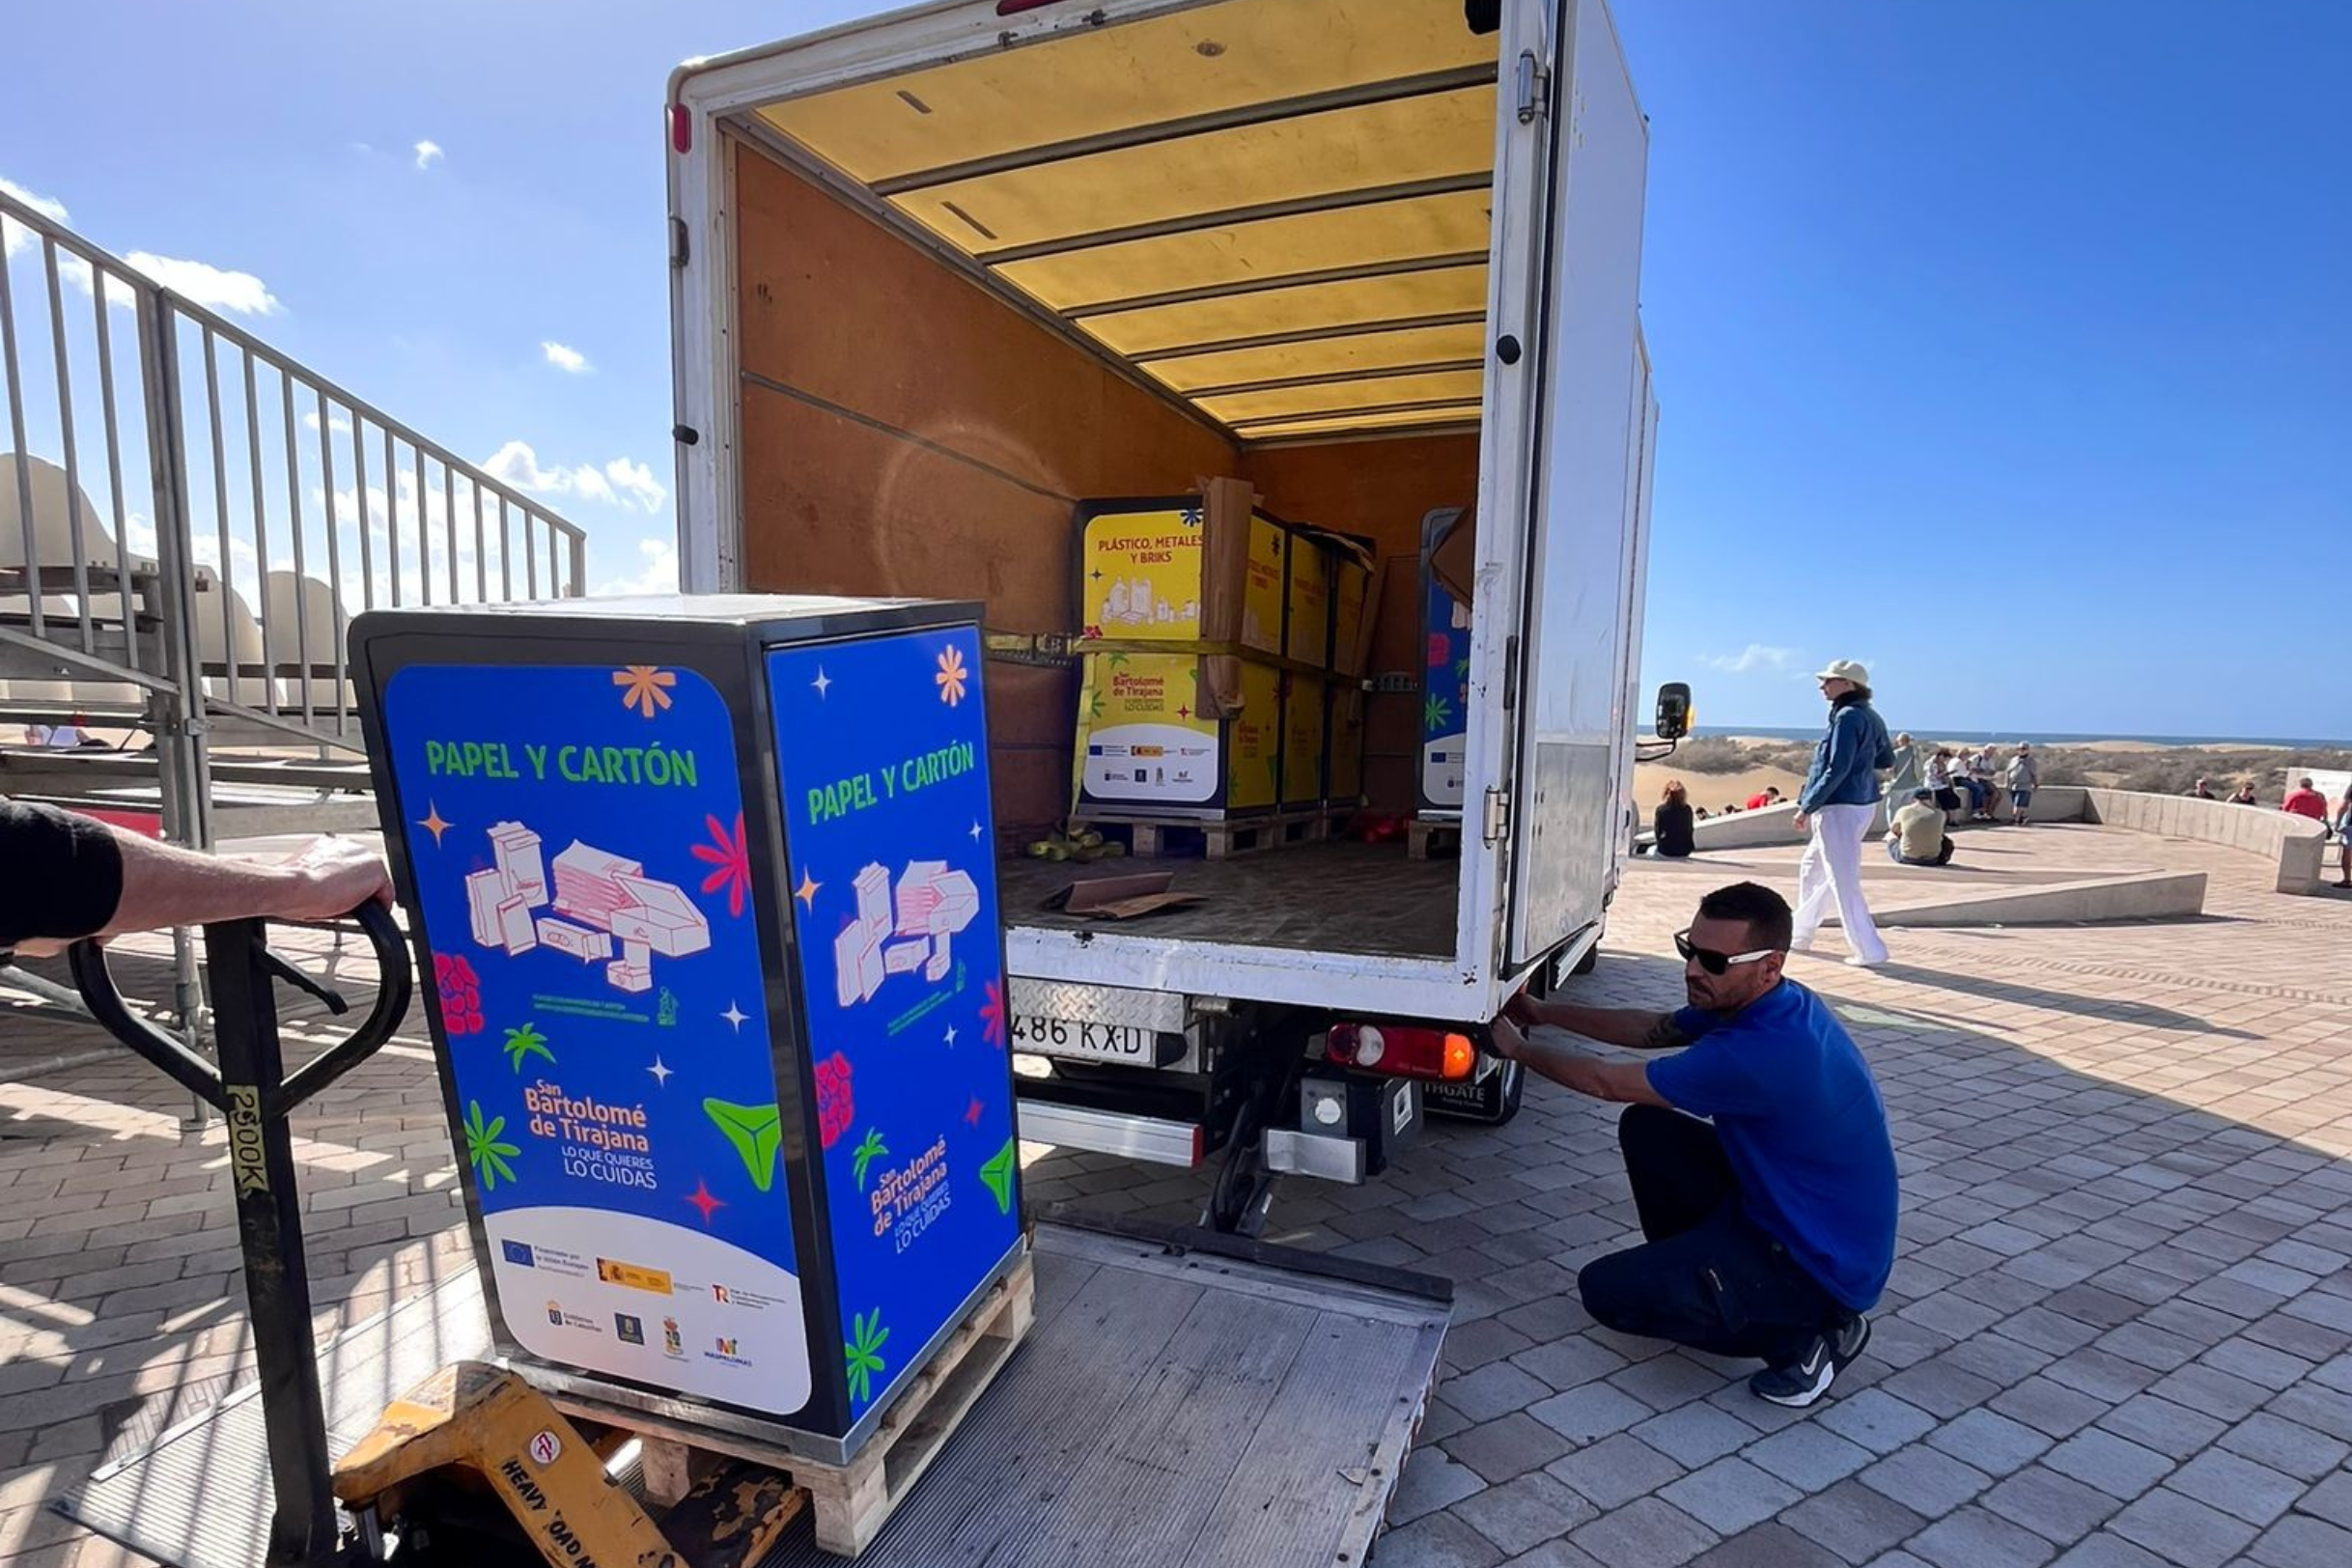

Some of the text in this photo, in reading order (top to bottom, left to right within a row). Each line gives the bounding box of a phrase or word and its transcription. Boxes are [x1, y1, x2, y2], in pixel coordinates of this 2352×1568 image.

[1098, 537, 1153, 551] PLÁSTICO,
[1131, 551, 1172, 564] Y BRIKS
[426, 741, 697, 787] PAPEL Y CARTÓN
[808, 740, 974, 825] PAPEL Y CARTÓN
[1081, 1022, 1140, 1054] KXD
[537, 1079, 561, 1096] San
[525, 1087, 646, 1128] Bartolomé
[530, 1114, 649, 1152] de Tirajana
[561, 1145, 654, 1169] LO QUE QUIERES
[565, 1158, 658, 1189] LO CUIDAS
[871, 1134, 946, 1215] Bartolomé
[875, 1212, 892, 1236] de
[894, 1162, 947, 1217] Tirajana
[897, 1230, 911, 1253] LO
[502, 1459, 581, 1555] HEAVY OAD
